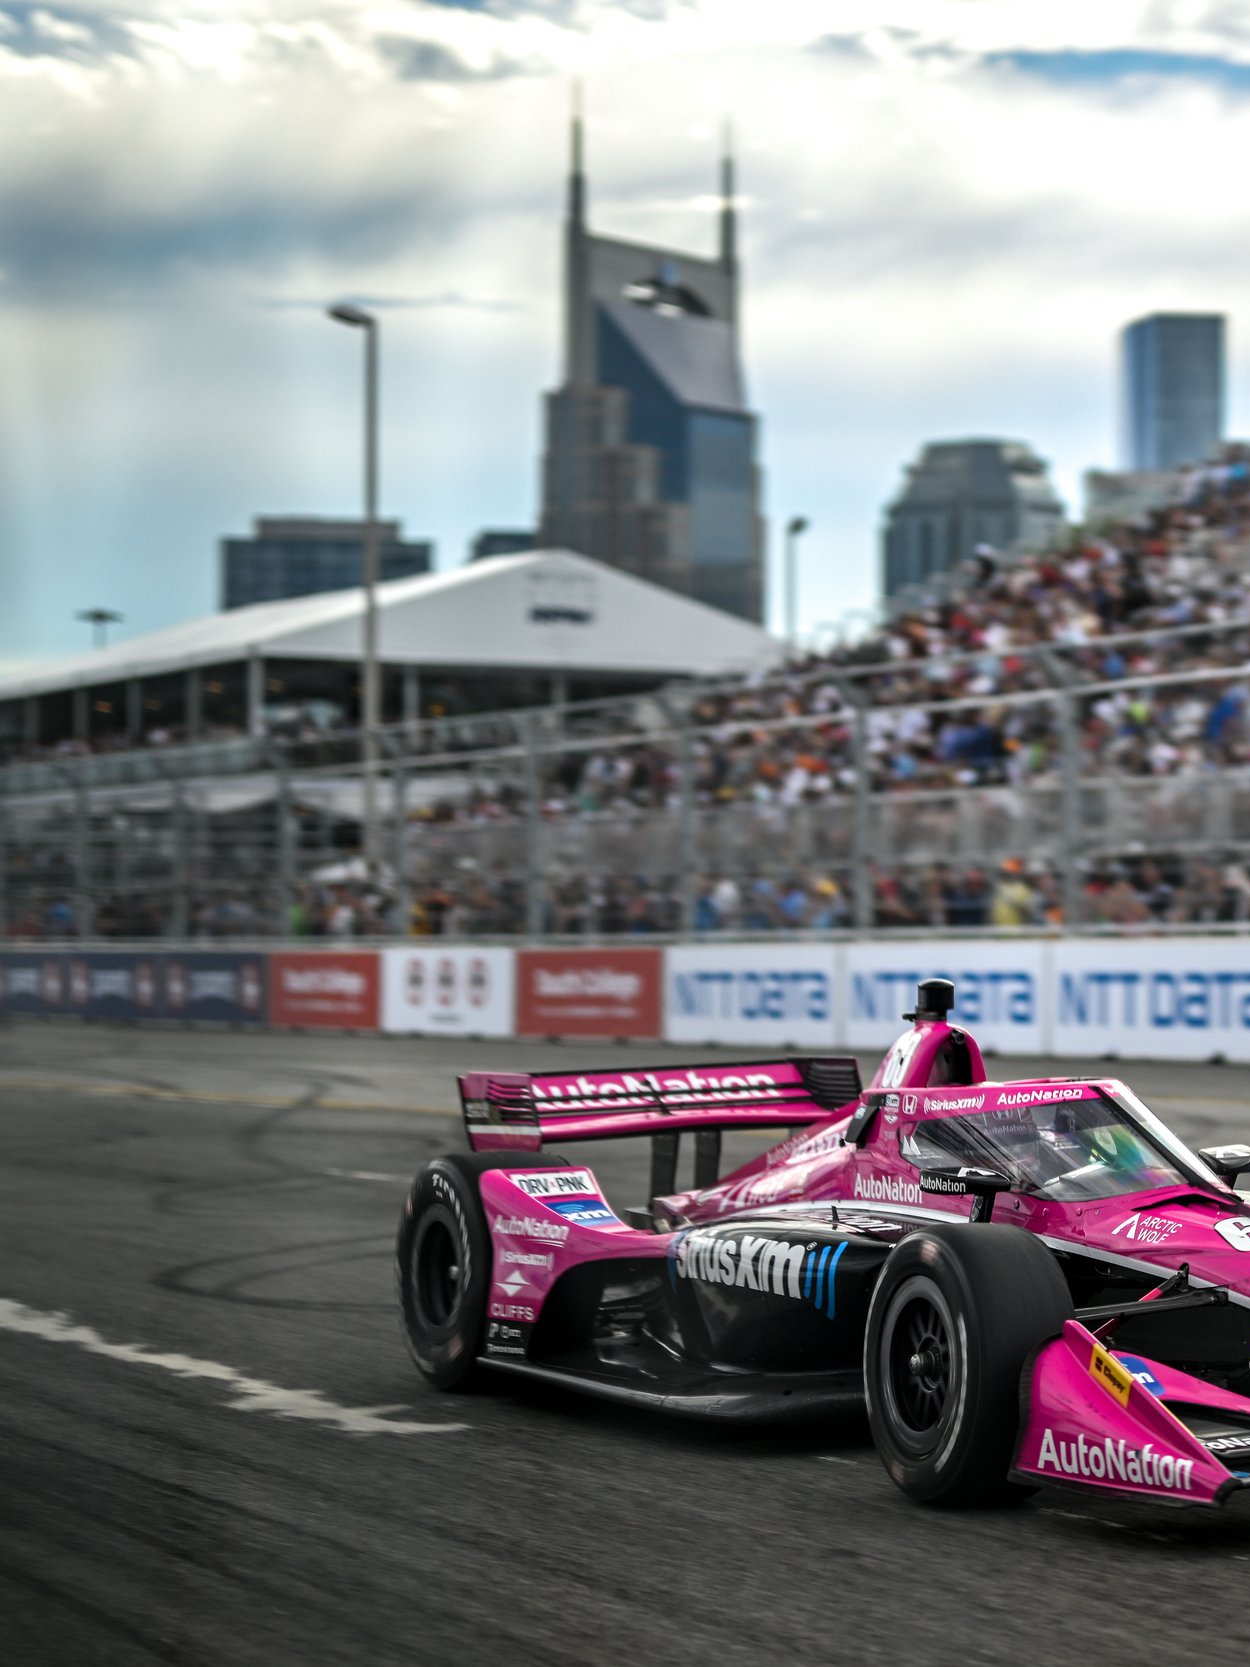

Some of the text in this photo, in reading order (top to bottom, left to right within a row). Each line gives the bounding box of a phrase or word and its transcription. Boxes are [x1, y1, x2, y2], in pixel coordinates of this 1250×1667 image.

[674, 971, 734, 1017] NTT
[851, 972, 1033, 1024] NTT ATA
[1060, 973, 1140, 1027] NTT
[997, 1088, 1083, 1105] AutoNation
[519, 1175, 589, 1195] DRV PNK
[854, 1172, 923, 1204] AutoNation
[920, 1175, 966, 1193] AutoNation
[494, 1214, 569, 1240] AutoNation
[1140, 1215, 1183, 1233] ARCTIC
[1137, 1228, 1170, 1244] WOLF
[491, 1303, 535, 1320] CLIFFS
[1037, 1428, 1194, 1490] AutoNation
